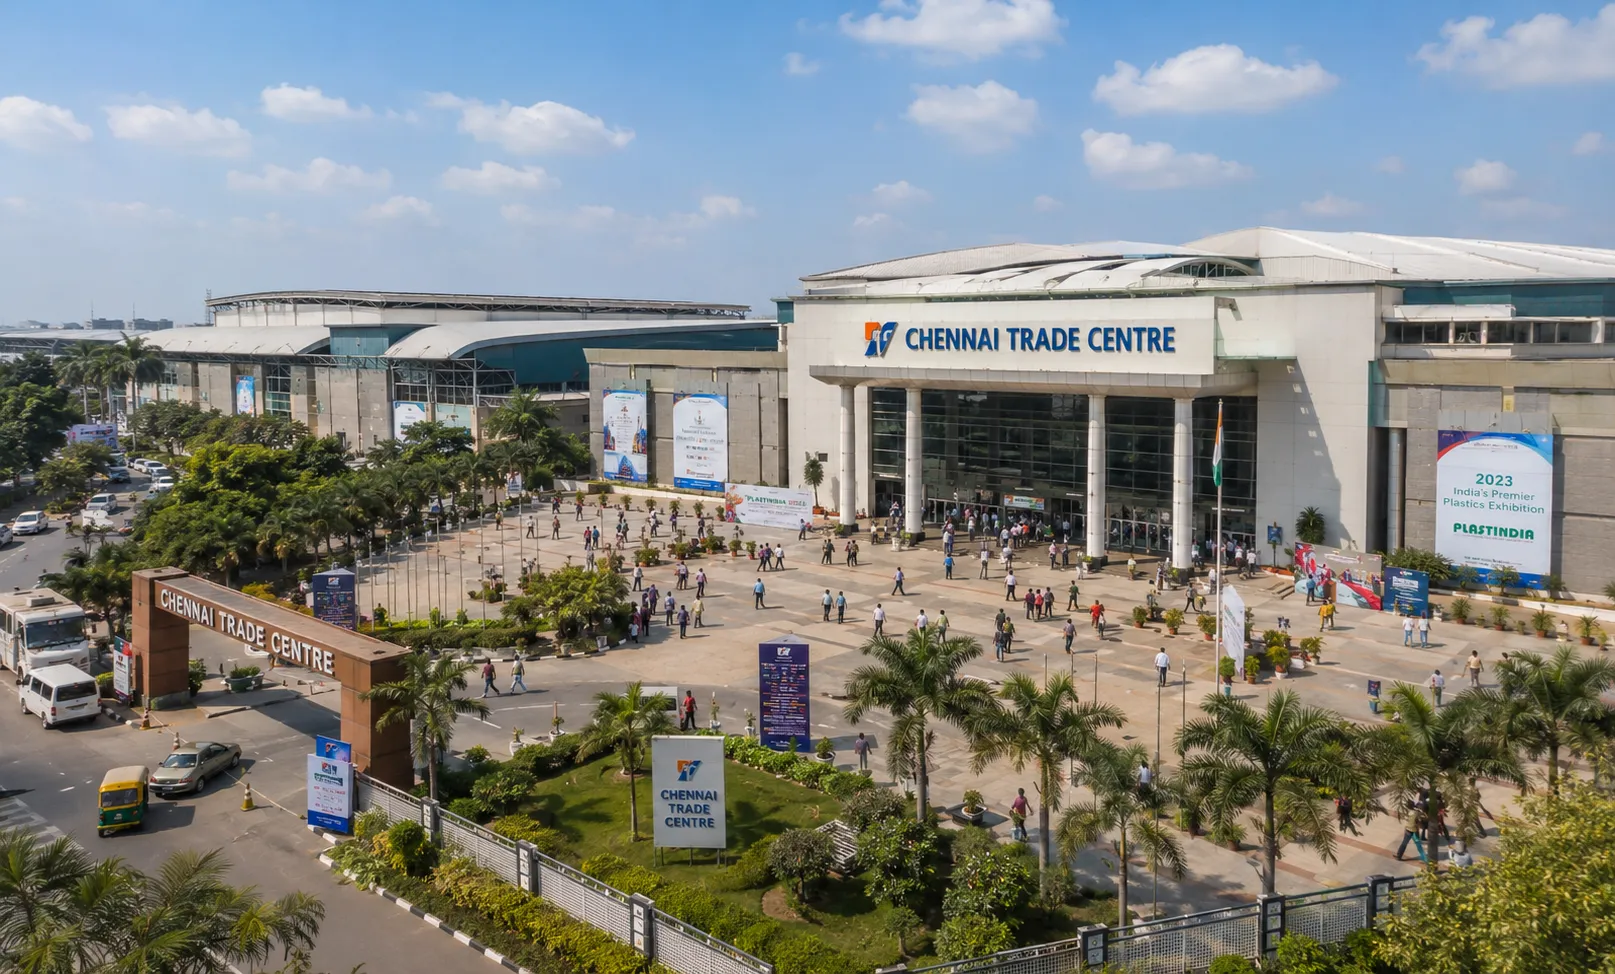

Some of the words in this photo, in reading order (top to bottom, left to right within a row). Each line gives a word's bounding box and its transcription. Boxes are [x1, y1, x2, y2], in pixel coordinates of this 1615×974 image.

[905, 327, 999, 351] CHENNAI
[1006, 327, 1080, 352] TRADE
[1088, 326, 1176, 352] CENTRE
[1475, 473, 1513, 487] 2023
[1453, 487, 1489, 498] India's
[1491, 490, 1535, 501] Premier
[1443, 498, 1485, 510] Plastics
[1488, 501, 1545, 514] Exhibition
[1453, 523, 1534, 539] PLASTINDIA
[160, 588, 215, 627] CHENNAI
[218, 610, 266, 648] TRADE
[271, 631, 335, 677] CENTRE
[661, 789, 718, 801] CHENNAI
[668, 803, 711, 815] TRADE
[664, 817, 715, 829] CENTRE
